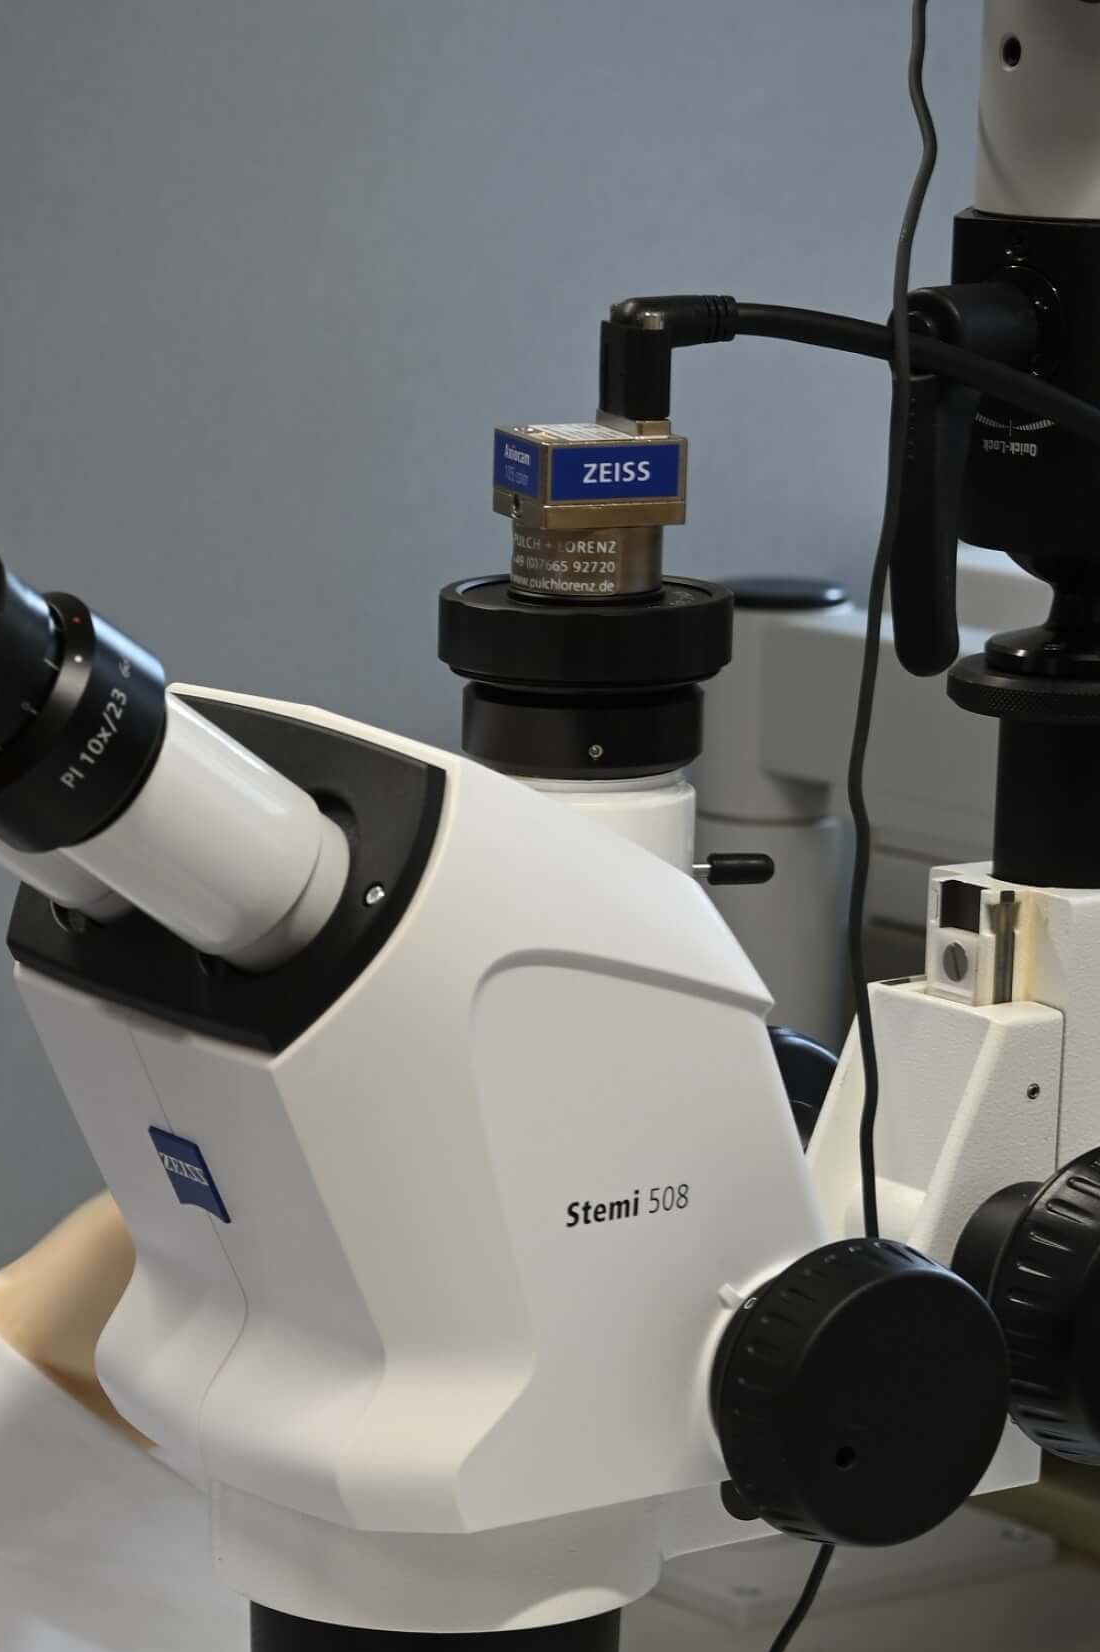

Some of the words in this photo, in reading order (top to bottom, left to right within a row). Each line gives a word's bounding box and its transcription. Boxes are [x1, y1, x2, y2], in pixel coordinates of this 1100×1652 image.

[582, 461, 651, 484] ZEISS
[572, 560, 616, 574] 92720
[80, 688, 127, 765] 10x/23
[565, 1189, 640, 1229] Stemi
[648, 1183, 690, 1215] 508
